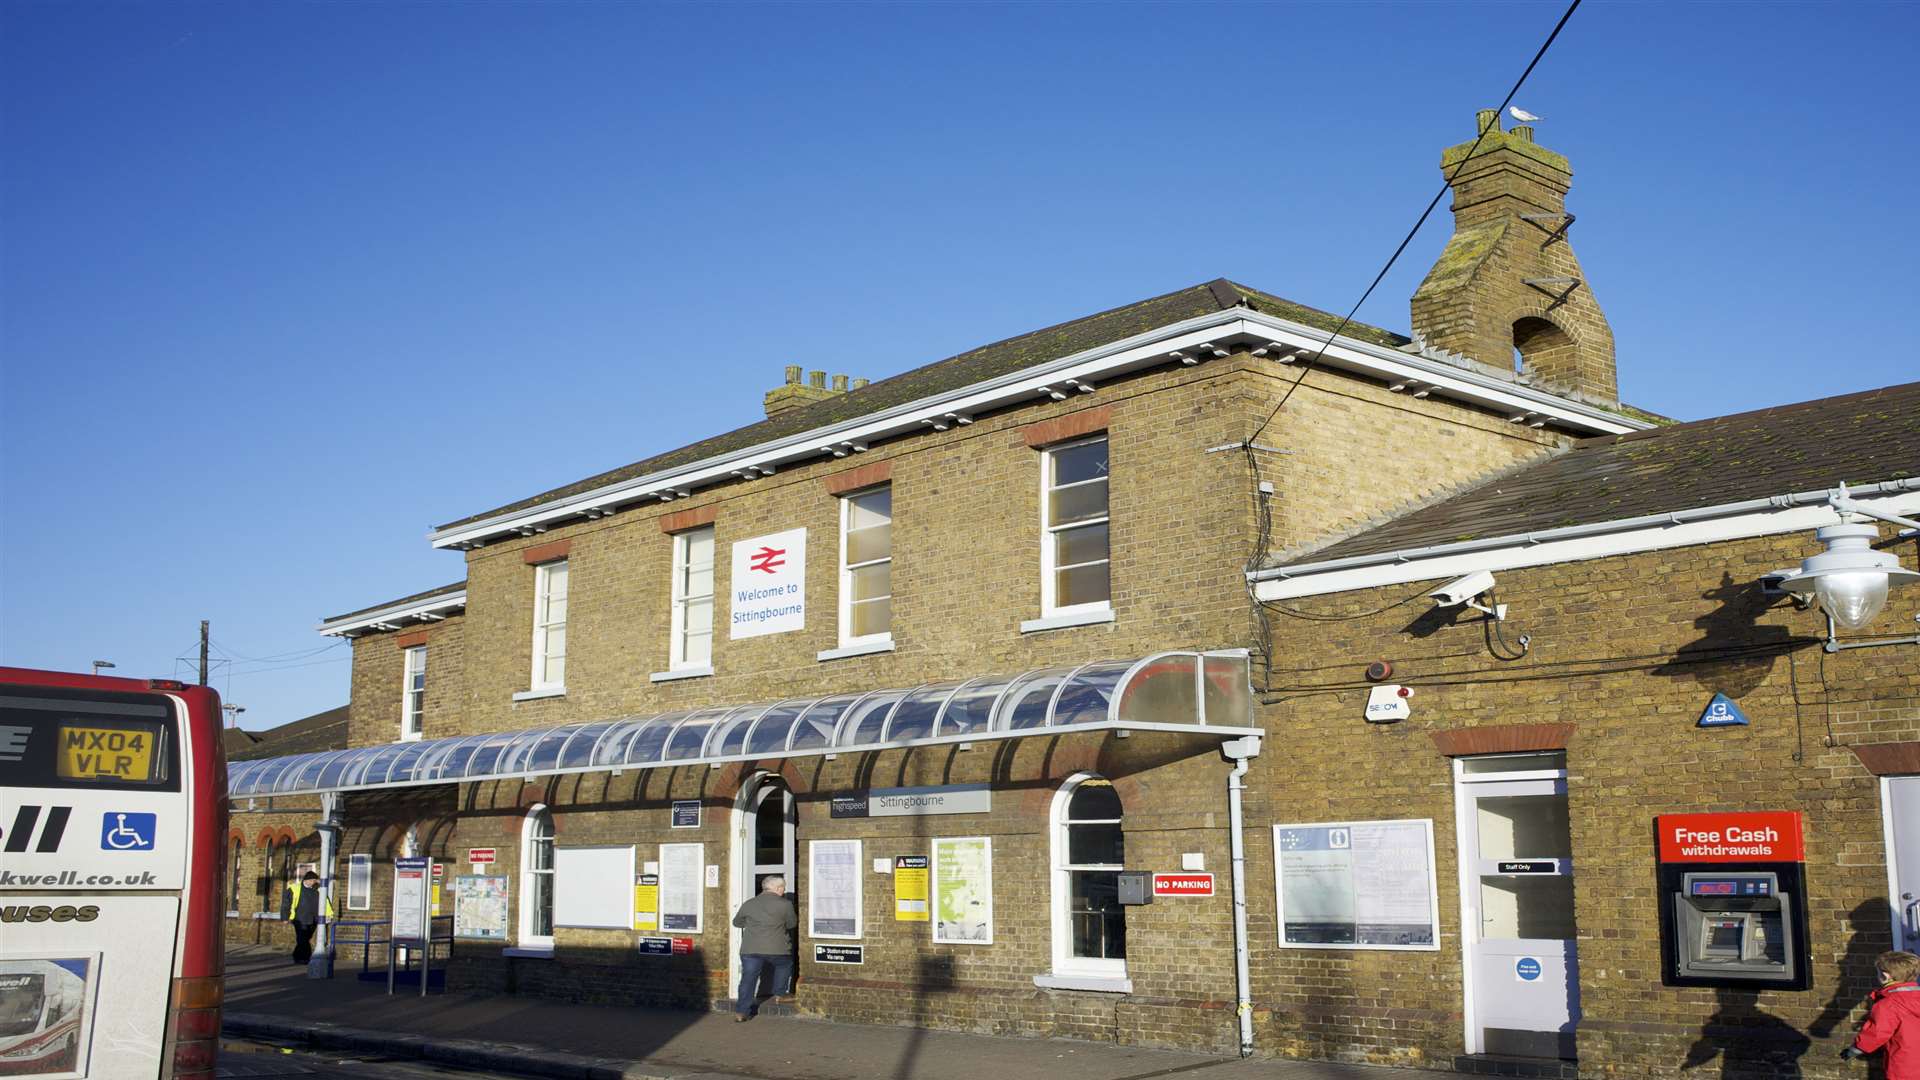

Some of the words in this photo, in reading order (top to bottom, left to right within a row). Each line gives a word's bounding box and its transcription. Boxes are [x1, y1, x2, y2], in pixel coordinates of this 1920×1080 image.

[738, 586, 784, 601] Welcome
[787, 584, 798, 594] to
[733, 604, 802, 623] Sittingbourne
[1370, 703, 1398, 711] SEOM
[1706, 714, 1734, 722] Chubb
[66, 730, 144, 752] MX04
[76, 753, 133, 774] VLR
[832, 800, 867, 813] highspeed
[880, 795, 944, 809] Sittingbourne
[0, 805, 72, 853] ll
[1675, 828, 1720, 843] Free
[1726, 826, 1778, 843] Cash
[1681, 844, 1772, 856] withdrawals
[0, 871, 157, 886] kwell.co.uk
[1156, 881, 1170, 889] NO
[1172, 881, 1211, 889] PARKING
[0, 905, 101, 923] uses
